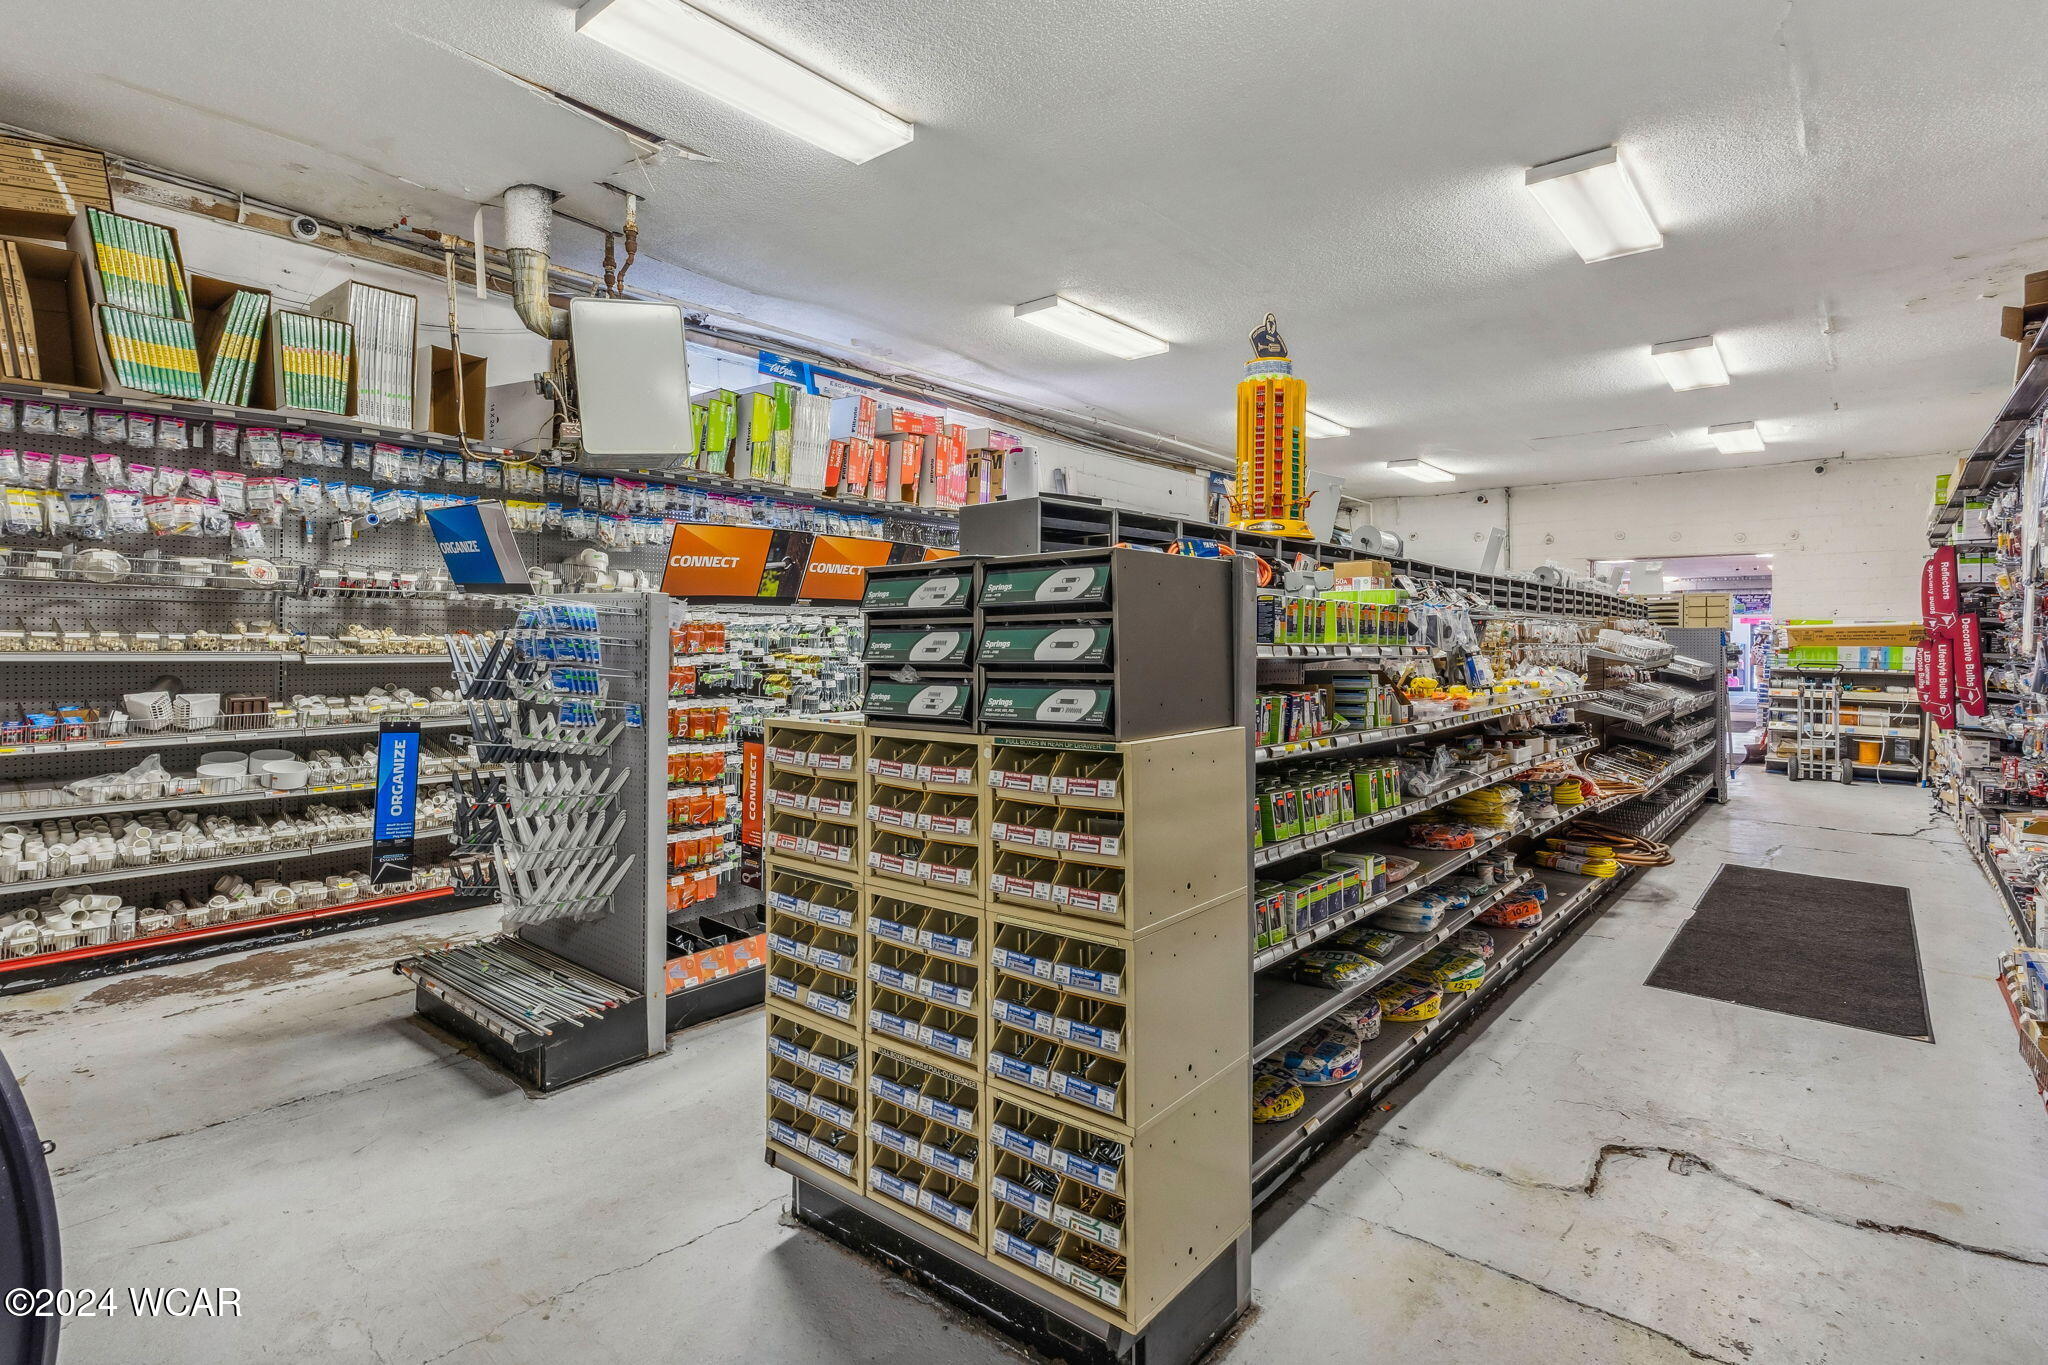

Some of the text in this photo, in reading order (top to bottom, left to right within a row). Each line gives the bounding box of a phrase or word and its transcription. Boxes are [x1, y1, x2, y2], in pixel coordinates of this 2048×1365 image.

[439, 540, 481, 554] ORGANIZE
[670, 555, 741, 568] CONNECT
[809, 562, 865, 576] CONNECT
[1940, 561, 1950, 600] Reflectors
[987, 583, 1013, 592] Springs
[867, 591, 890, 599] Springs
[870, 641, 892, 650] Springs
[984, 640, 1011, 649] Springs
[1961, 617, 1975, 688] Decorative Bulbs
[1937, 644, 1948, 699] Lifestyle Bulbs
[869, 692, 891, 701] Springs
[987, 698, 1013, 707] Springs
[390, 739, 407, 817] ORGANIZE
[749, 752, 757, 820] CONNECT
[1511, 906, 1530, 917] 10/2
